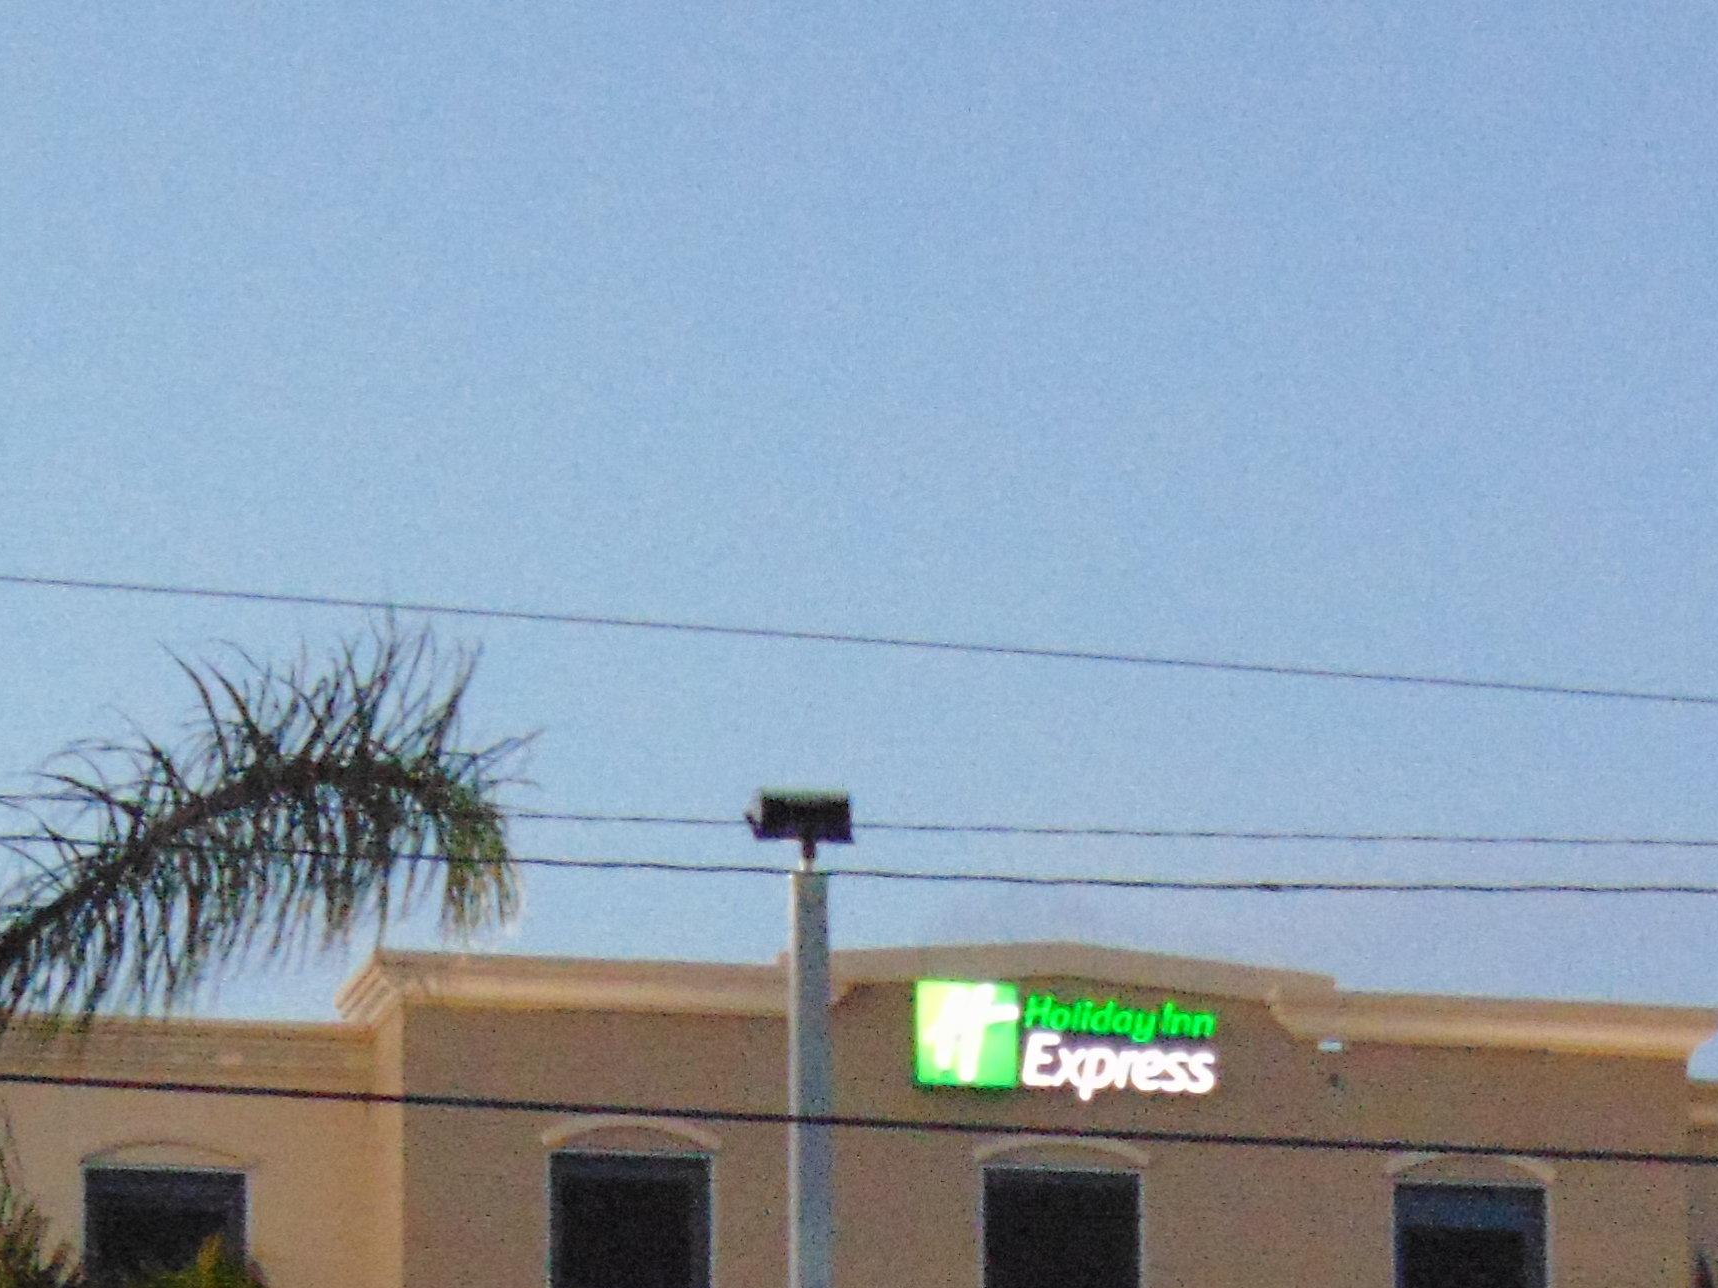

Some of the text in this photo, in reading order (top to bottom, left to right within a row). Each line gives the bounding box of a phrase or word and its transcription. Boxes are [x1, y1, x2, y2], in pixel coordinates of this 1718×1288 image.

[1024, 993, 1216, 1043] Holiday Inn
[1021, 1031, 1217, 1101] Express
